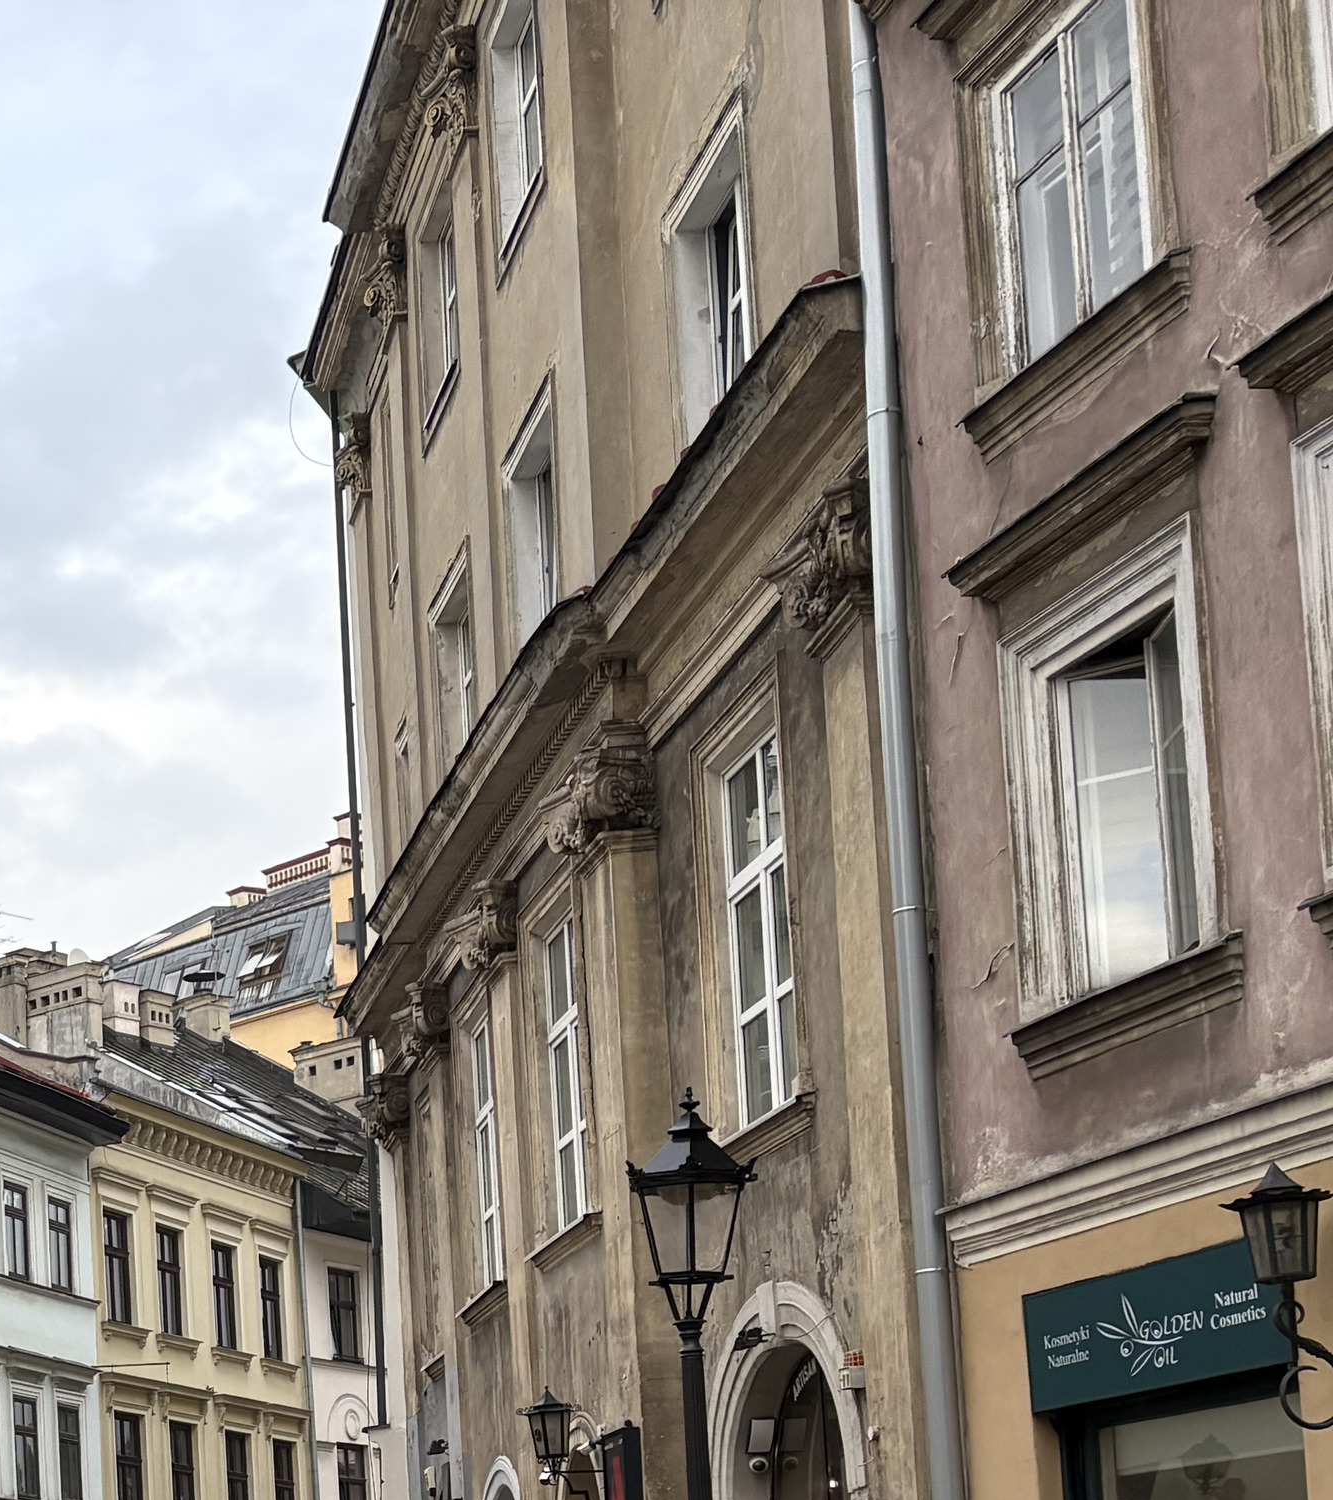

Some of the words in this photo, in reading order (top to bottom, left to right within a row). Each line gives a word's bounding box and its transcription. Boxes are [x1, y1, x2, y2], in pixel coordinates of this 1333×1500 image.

[1214, 1282, 1258, 1309] Natural
[1139, 1310, 1204, 1341] GOLDEN
[1210, 1304, 1267, 1330] Cosmetics
[1043, 1325, 1090, 1350] Kosmetyki
[1047, 1349, 1090, 1369] Naturalne
[1153, 1346, 1179, 1368] OIL
